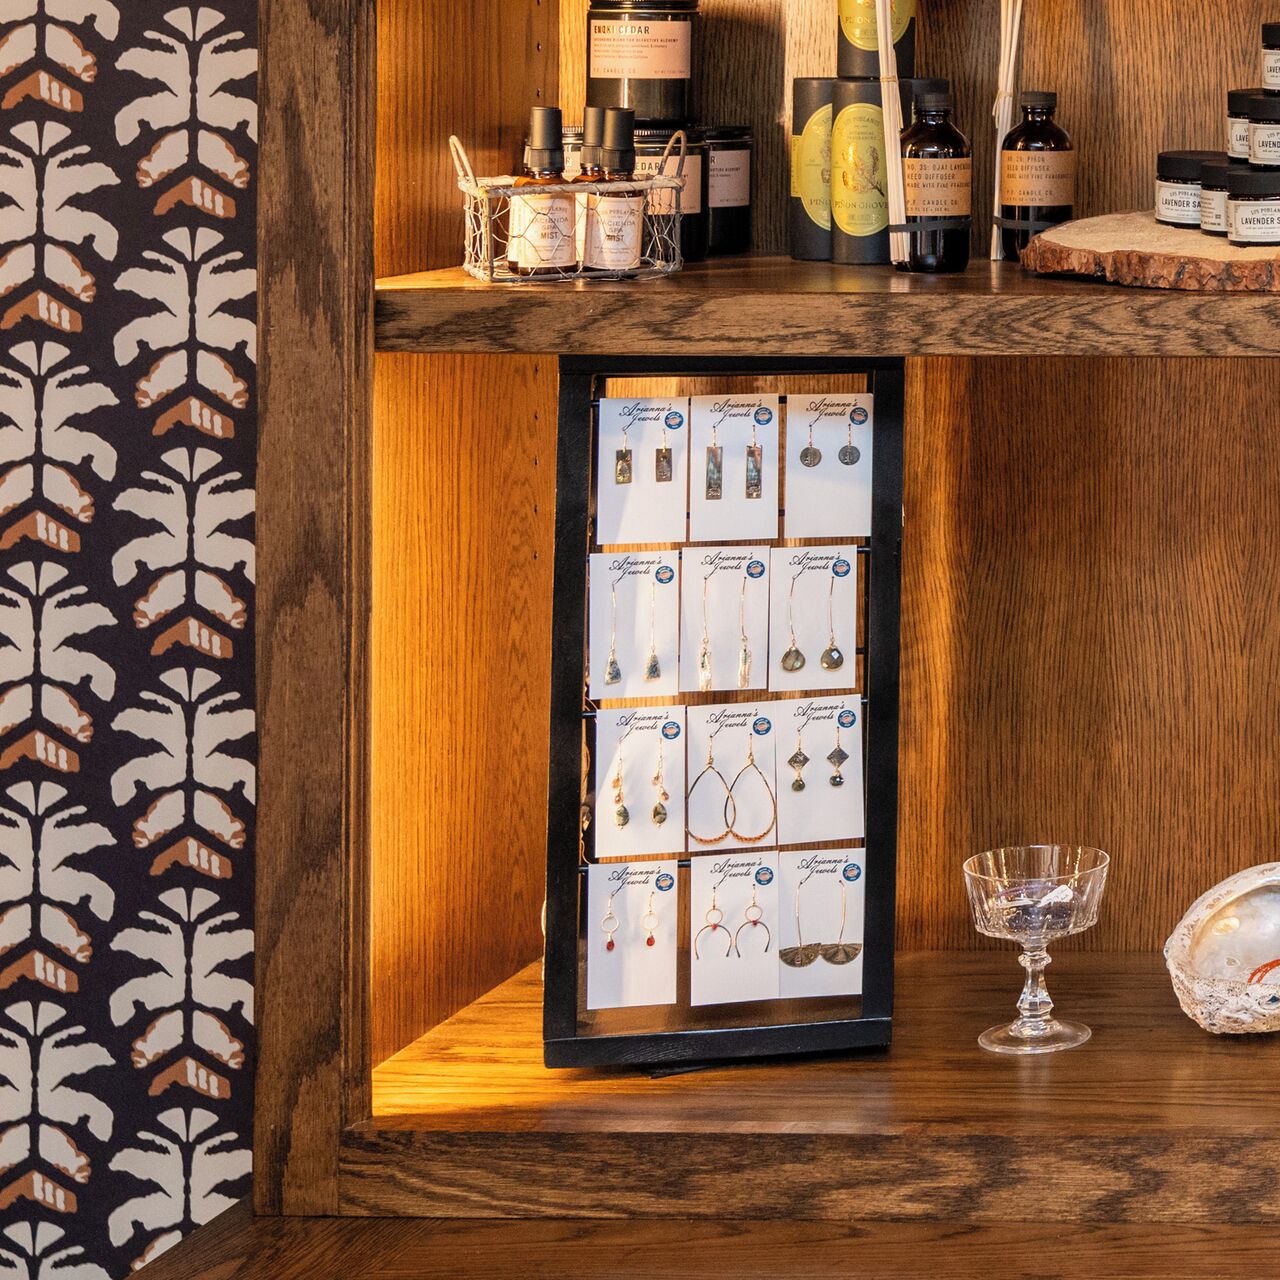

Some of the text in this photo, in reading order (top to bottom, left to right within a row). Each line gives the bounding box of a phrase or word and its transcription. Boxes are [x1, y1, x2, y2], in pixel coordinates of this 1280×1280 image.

[619, 402, 672, 417] Arianna's
[710, 398, 762, 413] Arianna's
[806, 398, 858, 412] Arianna's
[624, 412, 660, 432] Jewels
[715, 408, 751, 427] Jewels
[810, 407, 846, 426] Jewels
